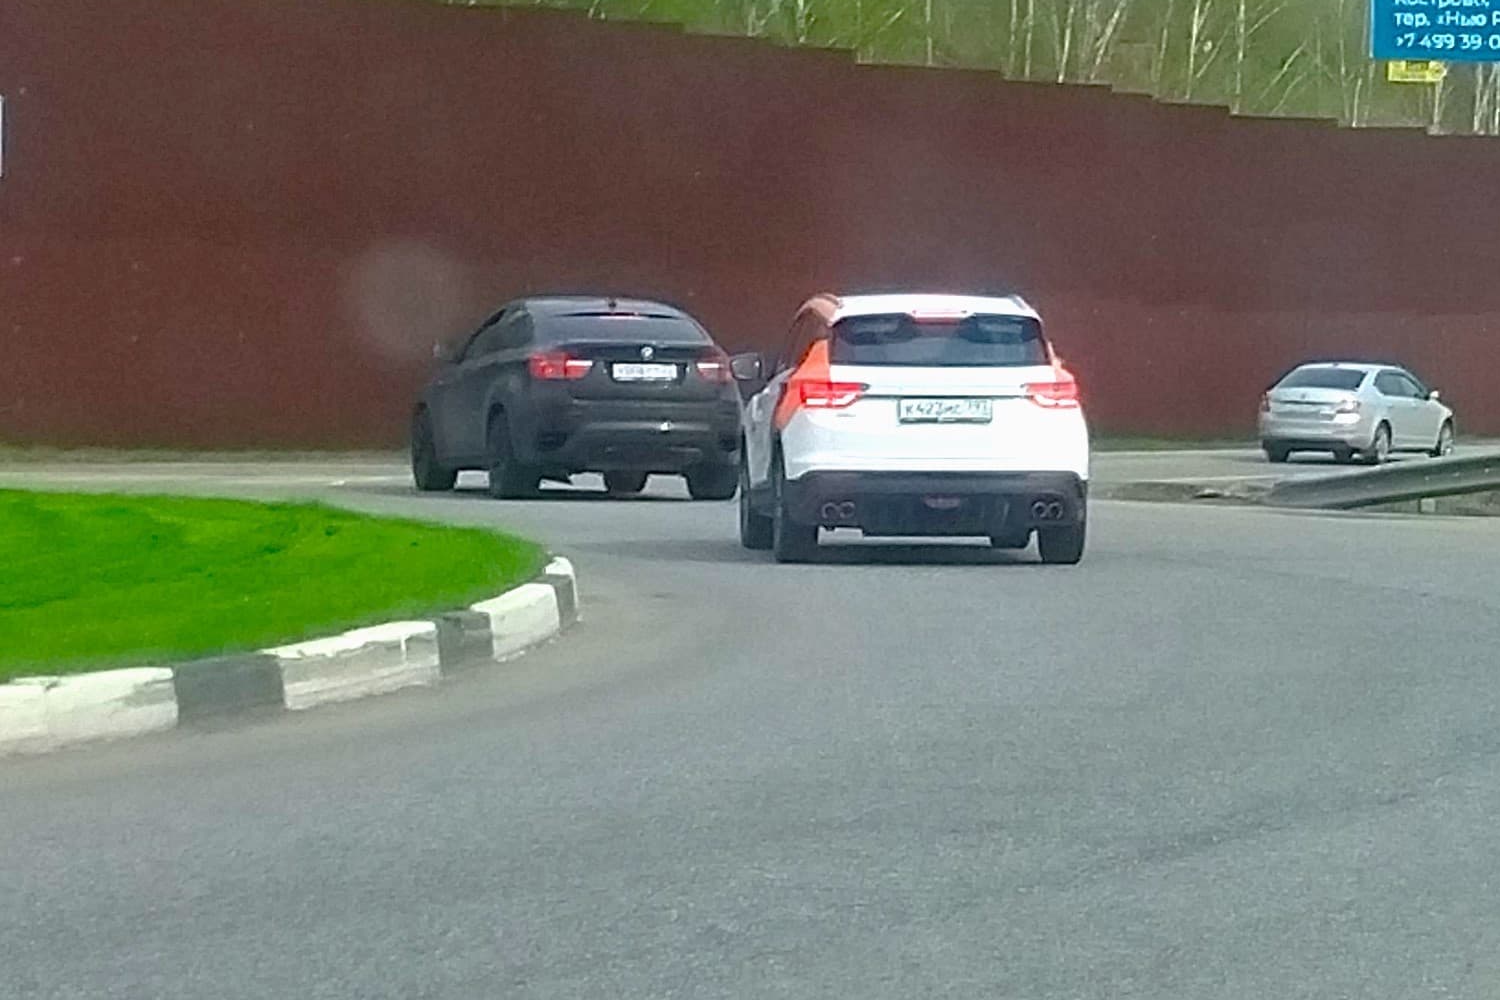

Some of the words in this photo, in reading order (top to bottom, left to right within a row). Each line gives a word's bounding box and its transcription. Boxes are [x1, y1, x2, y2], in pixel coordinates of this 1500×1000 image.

[1394, 12, 1431, 28] тер.
[1396, 33, 1415, 48] +7
[1418, 34, 1455, 50] 499
